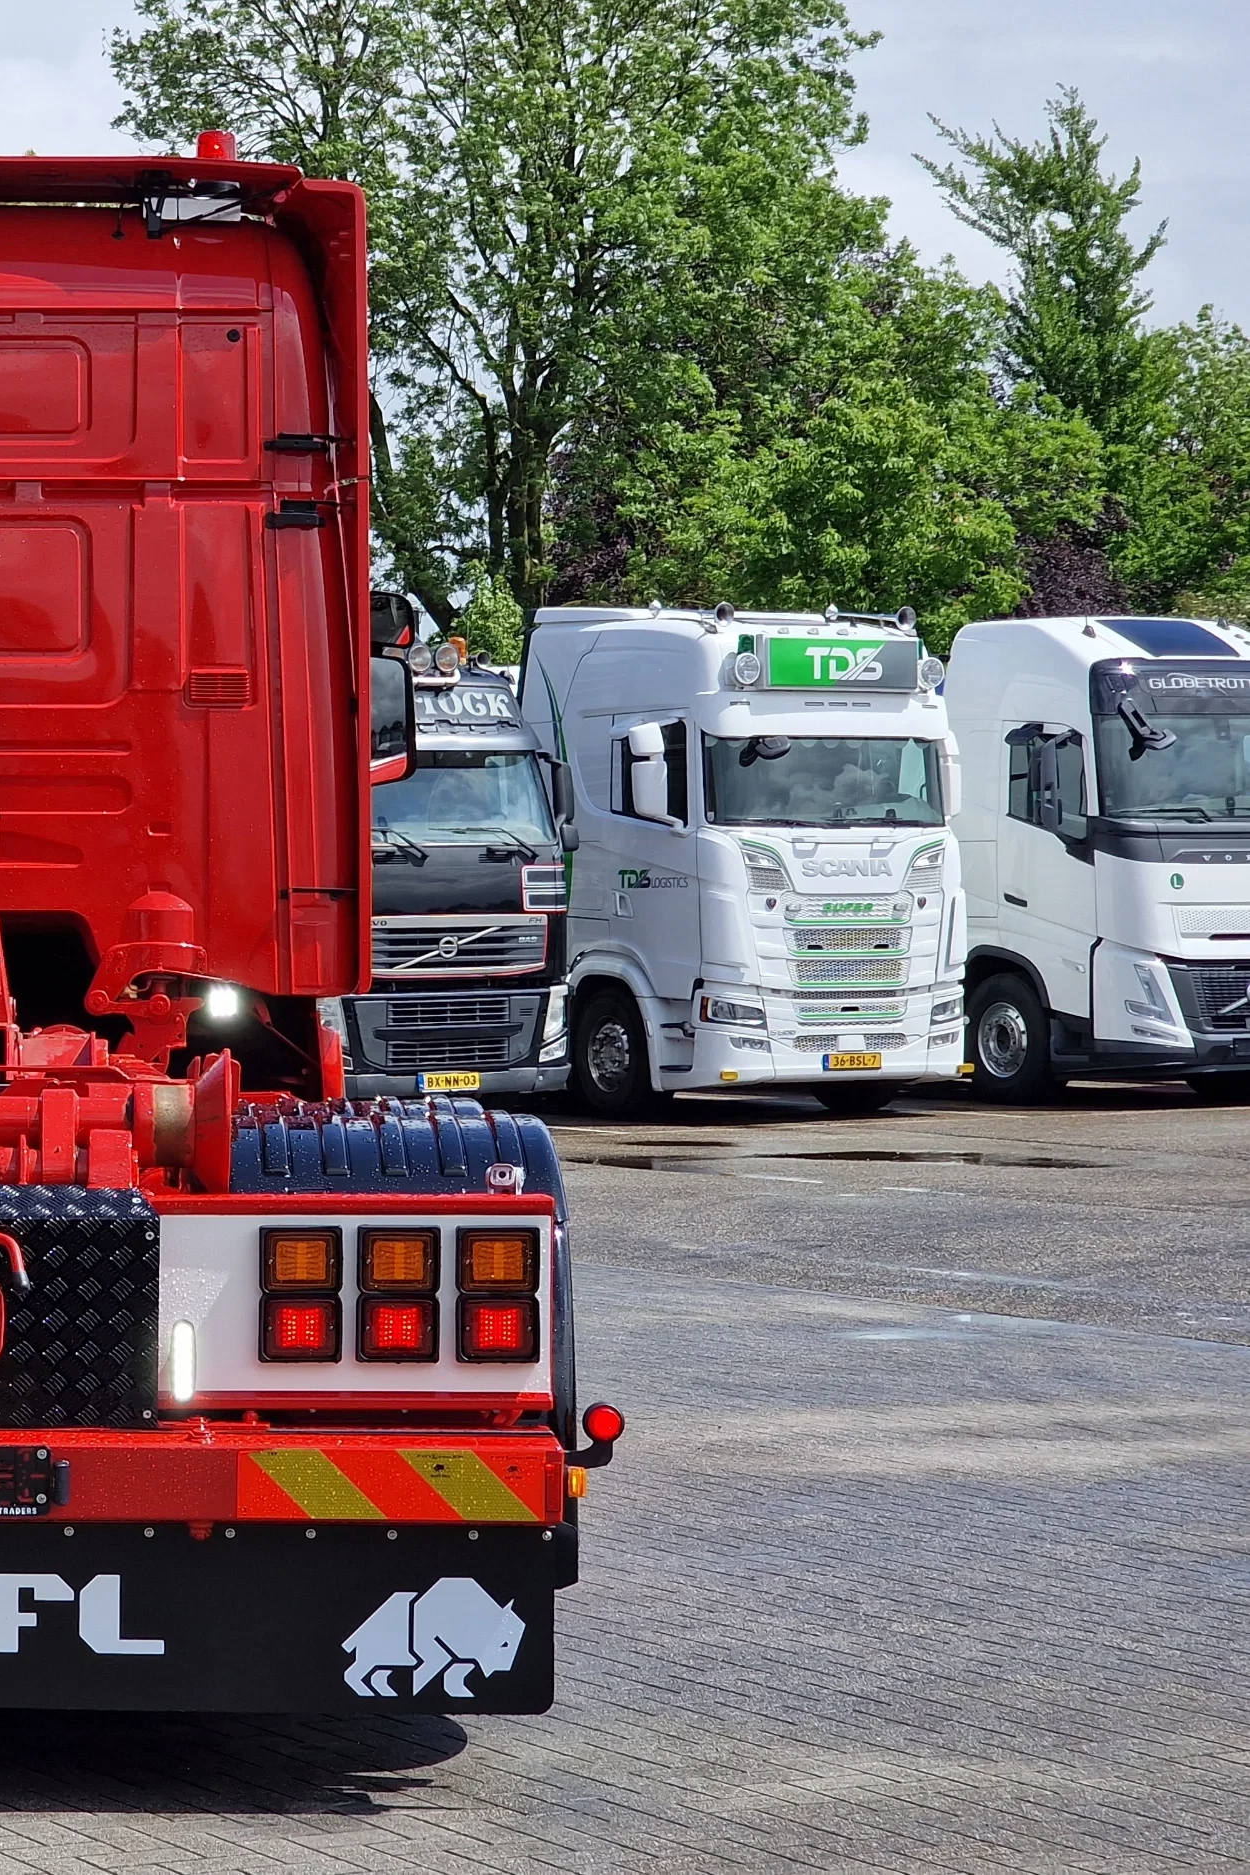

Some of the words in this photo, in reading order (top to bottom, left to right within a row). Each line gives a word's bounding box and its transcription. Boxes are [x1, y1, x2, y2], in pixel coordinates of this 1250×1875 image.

[805, 643, 886, 681] TDS
[1149, 677, 1250, 689] GLOBETROT
[802, 859, 893, 877] SCANIA
[618, 868, 651, 889] TDS
[651, 876, 688, 889] LOGISTICS
[833, 1055, 877, 1068] 36-BSL-7
[427, 1074, 478, 1088] BX-NN-03
